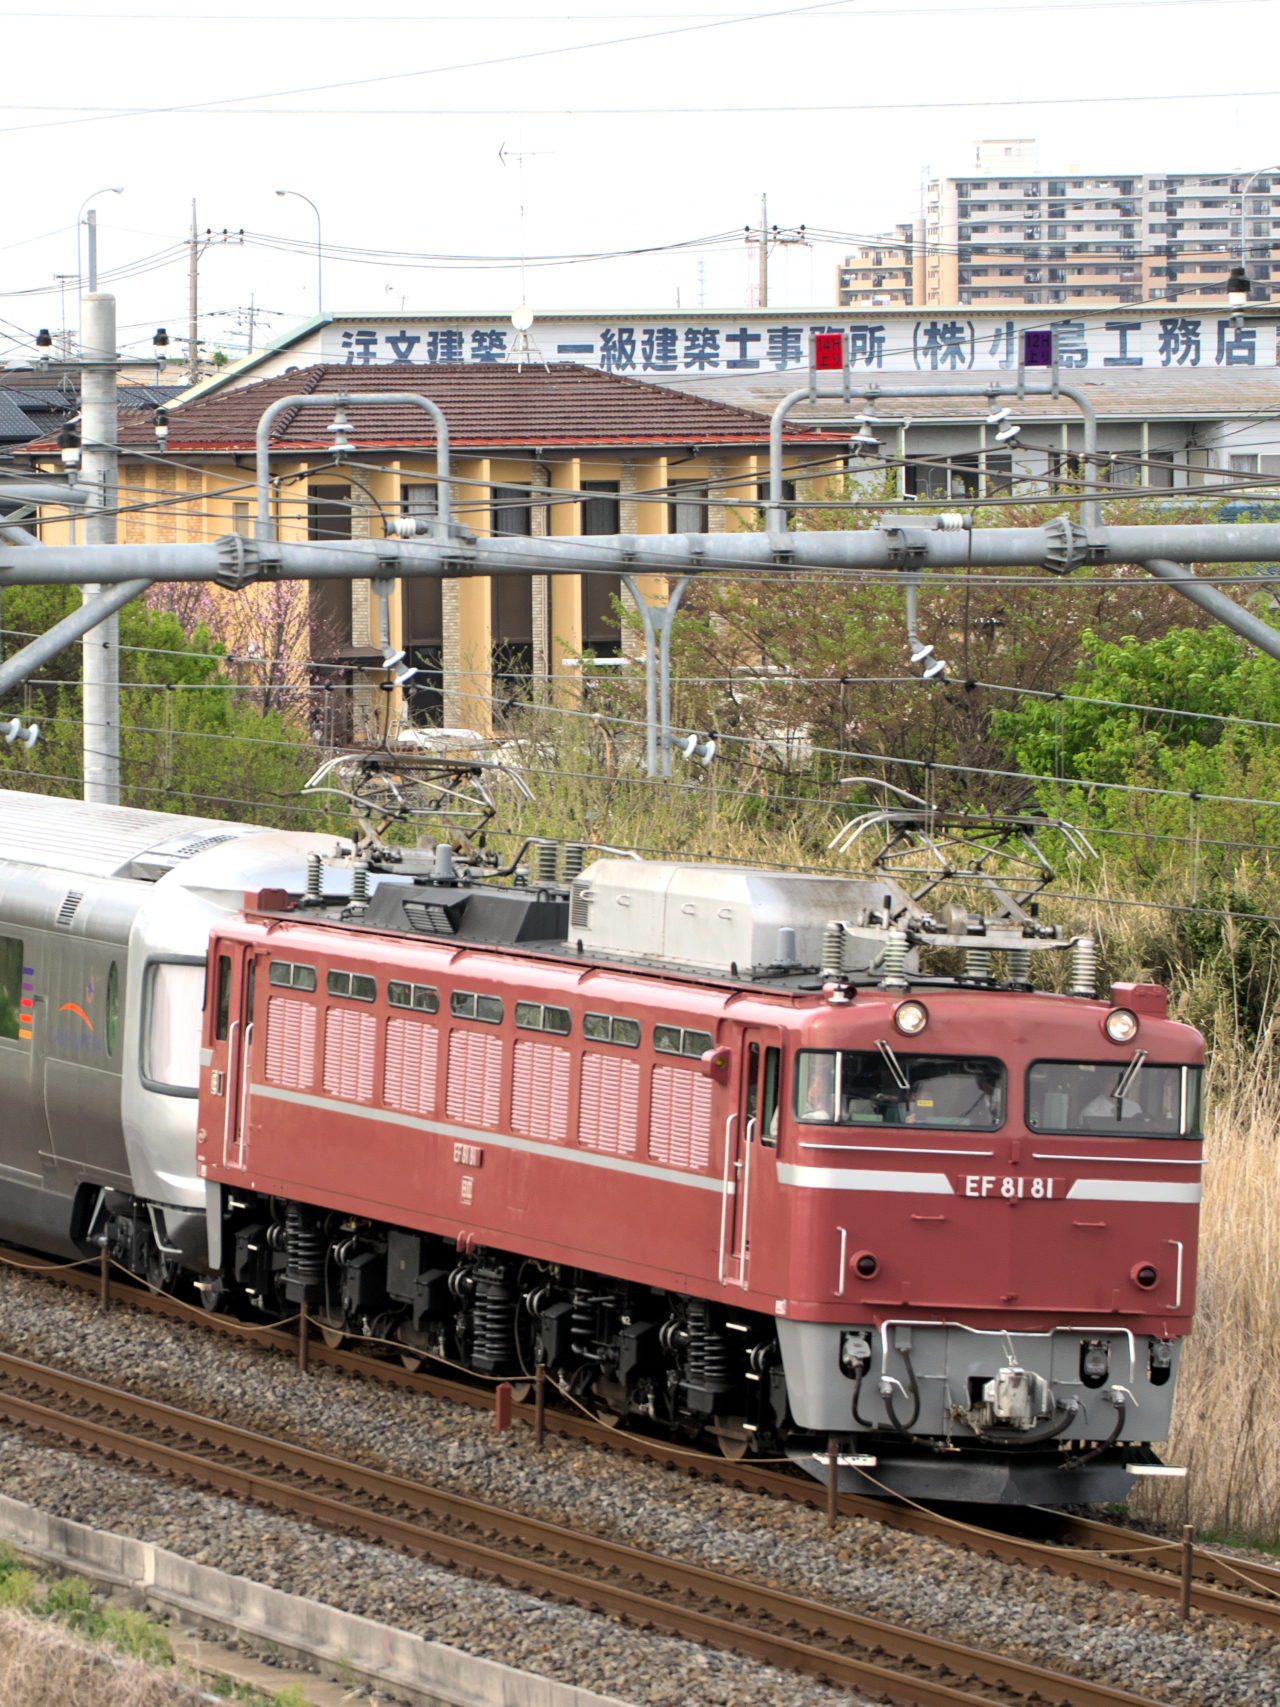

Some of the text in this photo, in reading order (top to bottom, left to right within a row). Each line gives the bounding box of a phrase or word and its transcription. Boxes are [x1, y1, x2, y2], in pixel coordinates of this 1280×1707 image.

[341, 329, 508, 364] 注文建築
[557, 324, 886, 372] 一級建築士事所
[966, 1175, 1053, 1199] EF 81 81
